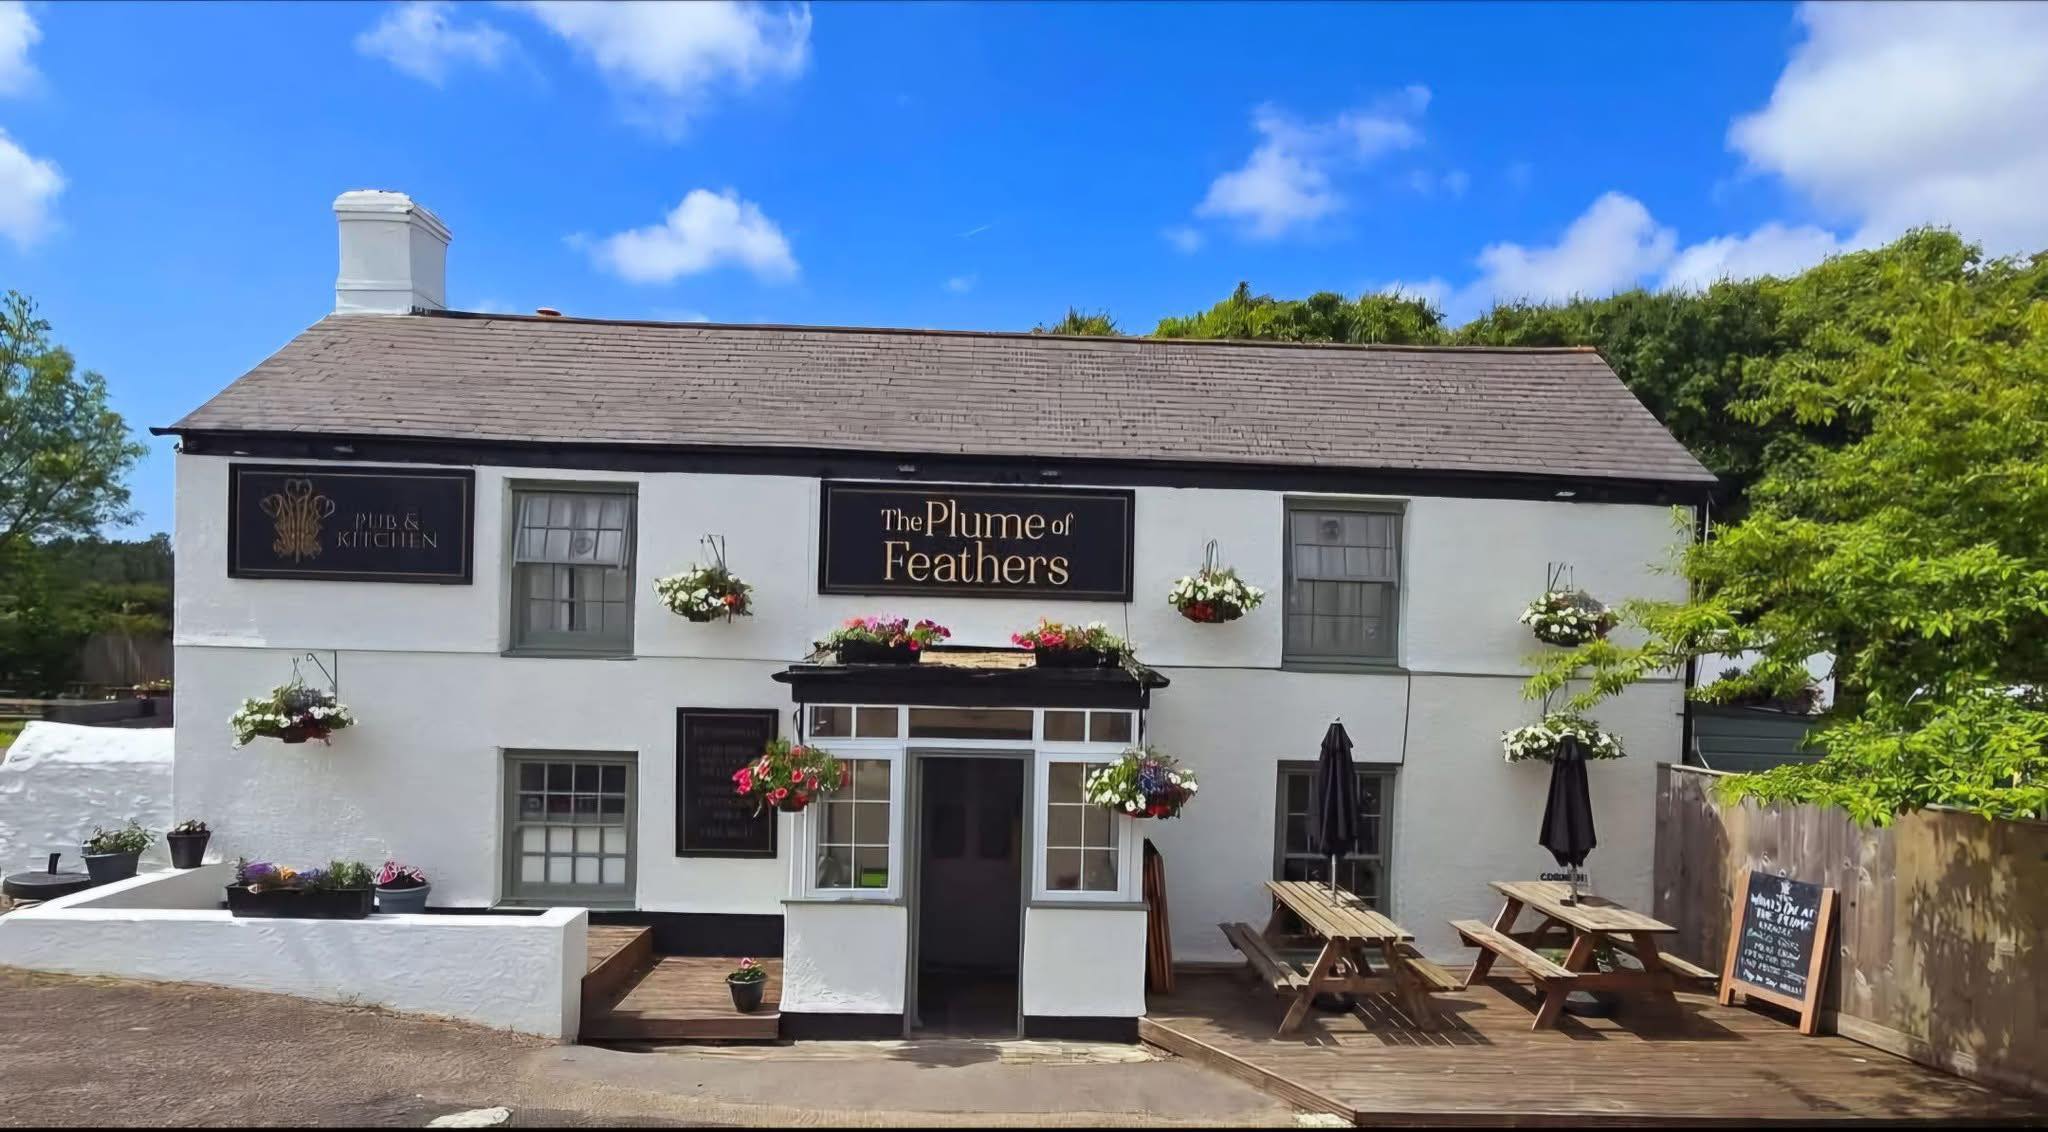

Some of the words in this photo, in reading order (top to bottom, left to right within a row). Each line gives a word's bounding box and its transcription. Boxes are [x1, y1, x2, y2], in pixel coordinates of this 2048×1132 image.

[355, 512, 397, 531] PUB
[404, 512, 420, 530] &
[881, 508, 922, 532] The
[925, 500, 1046, 540] Plume
[1051, 512, 1074, 536] of
[337, 530, 438, 549] KITCHEN
[883, 540, 1070, 585] Feathers
